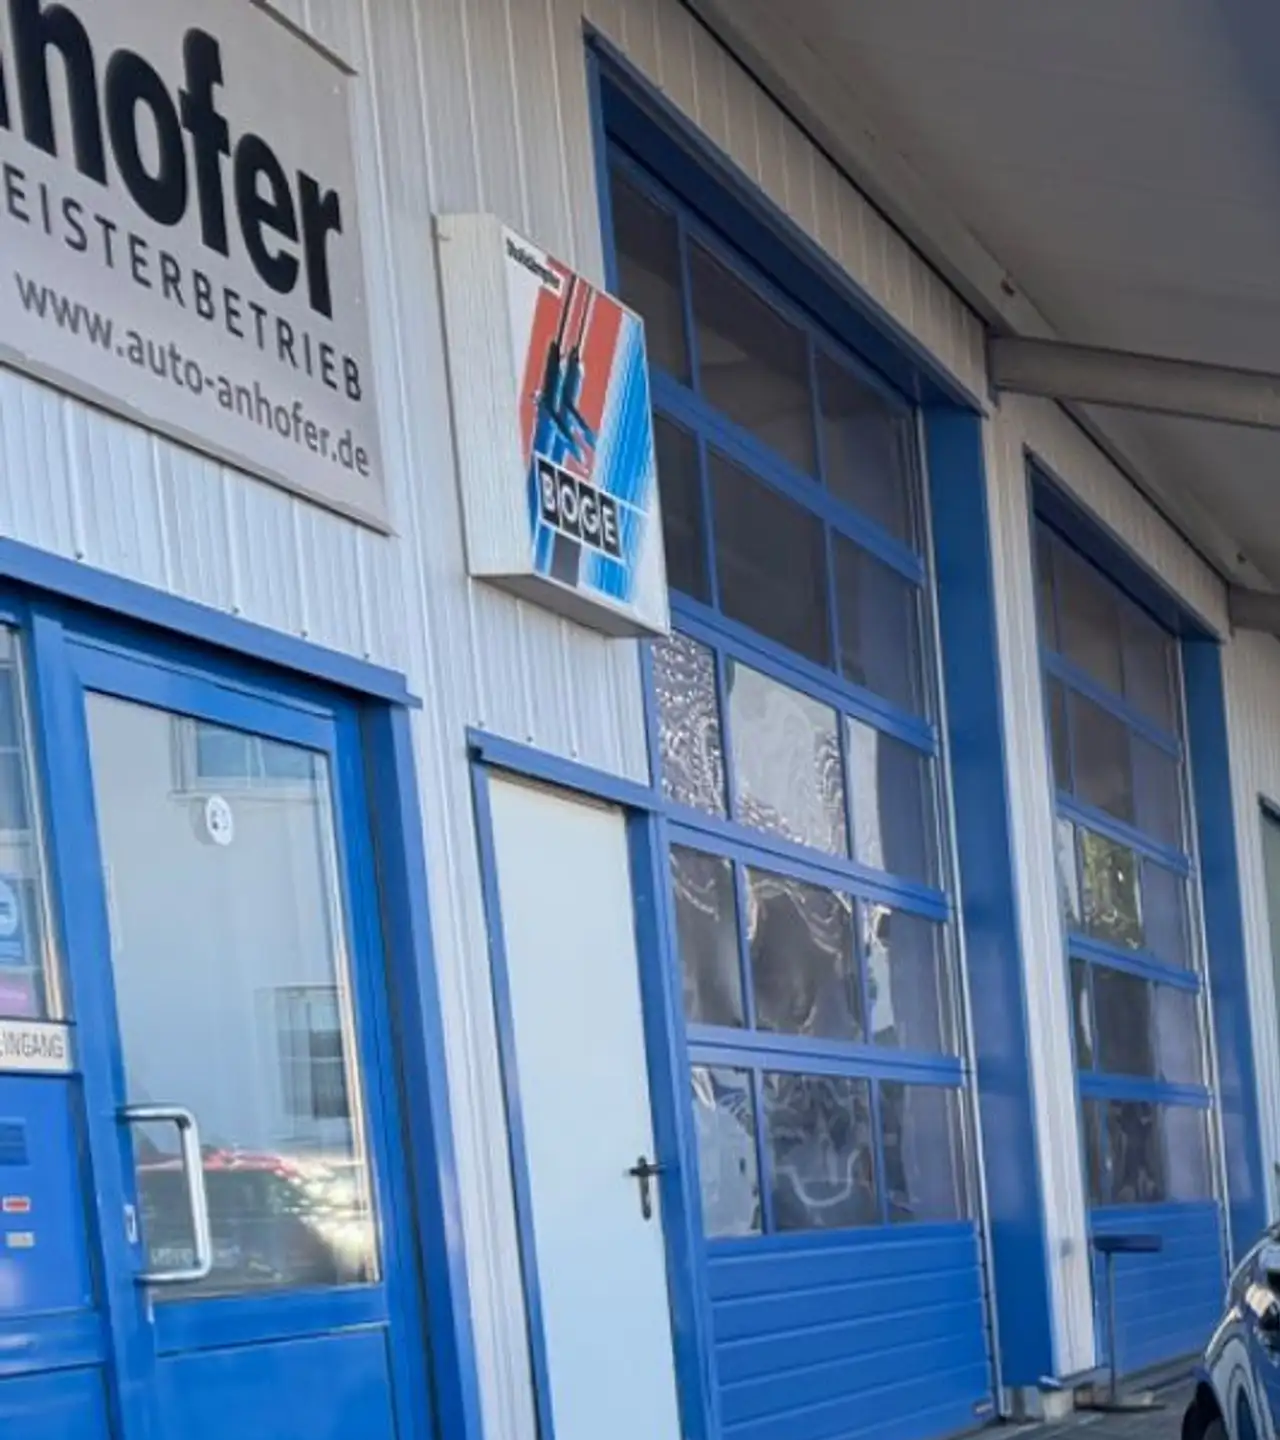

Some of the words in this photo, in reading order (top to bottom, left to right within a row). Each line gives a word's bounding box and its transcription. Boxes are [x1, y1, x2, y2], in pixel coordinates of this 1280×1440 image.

[0, 0, 342, 320] hofer
[3, 161, 363, 402] EISTERBETRIEB
[15, 271, 371, 477] www.auto-anhofer.de
[540, 471, 617, 545] BOGE
[0, 1031, 64, 1060] INGANG
